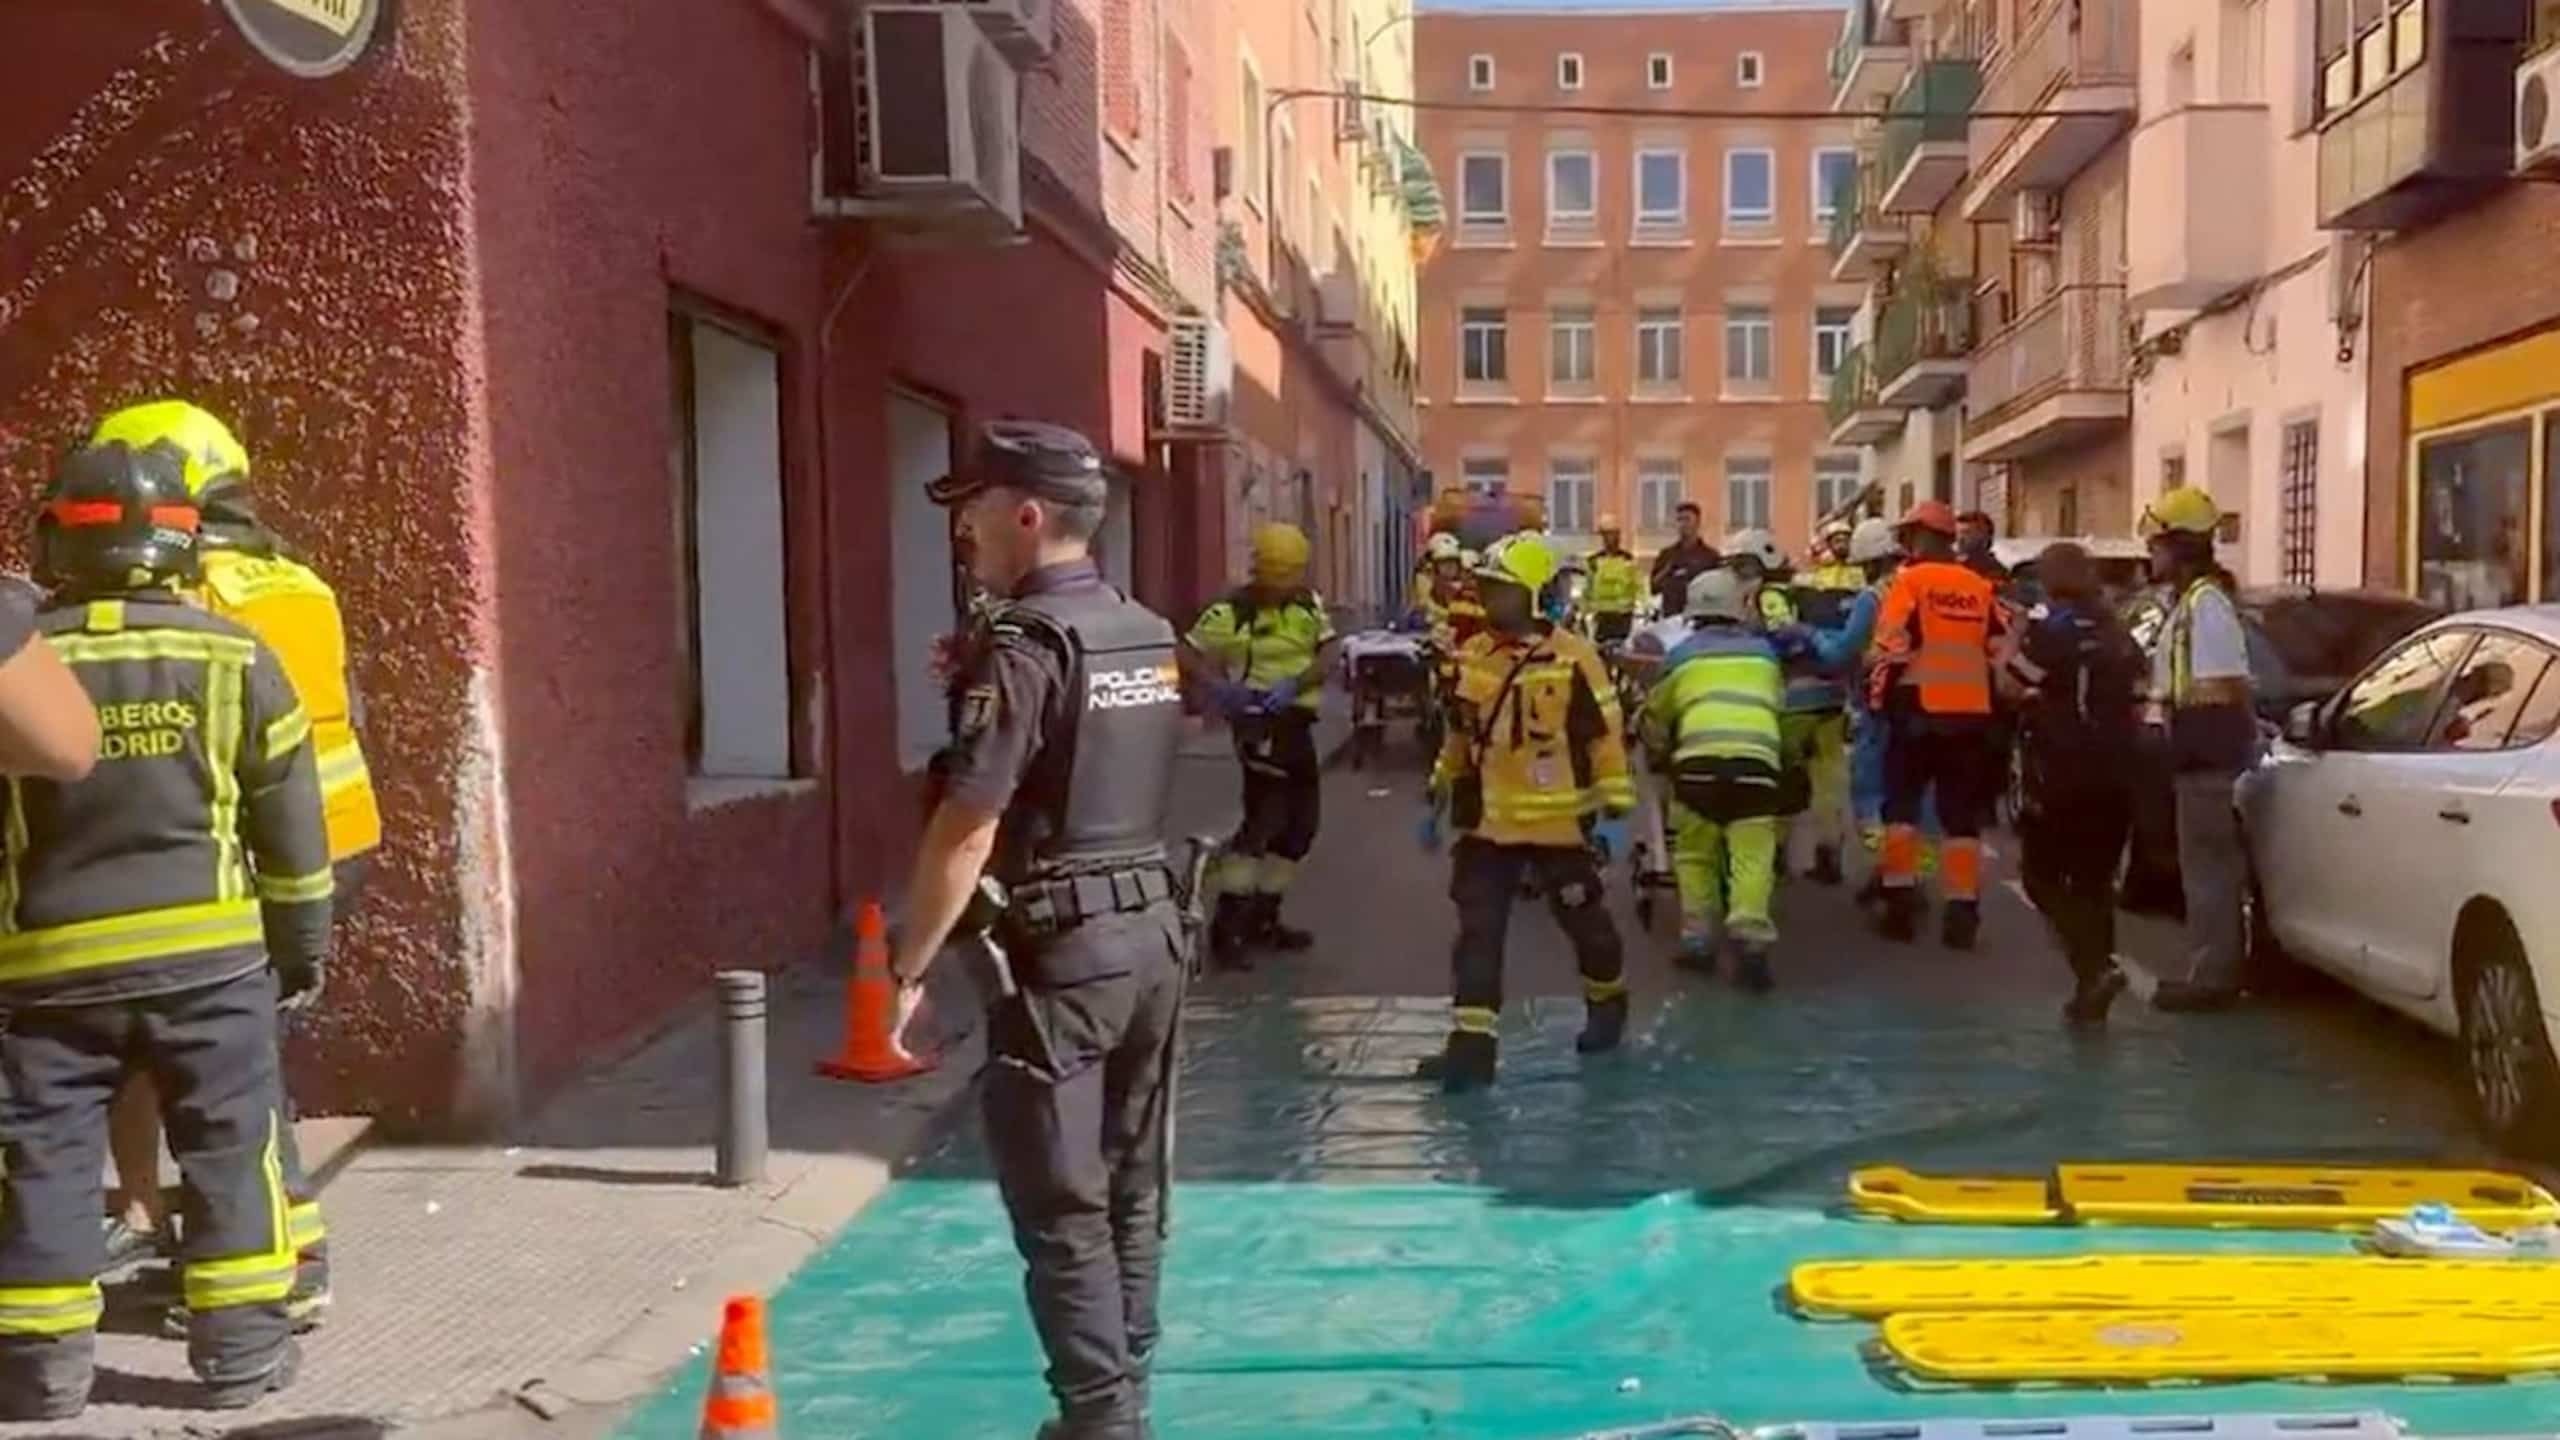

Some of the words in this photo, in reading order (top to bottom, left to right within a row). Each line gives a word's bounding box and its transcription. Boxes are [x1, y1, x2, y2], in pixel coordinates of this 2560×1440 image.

[1088, 686, 1181, 711] NACIONAL
[101, 700, 198, 729] BEROS
[97, 729, 184, 759] DRID
